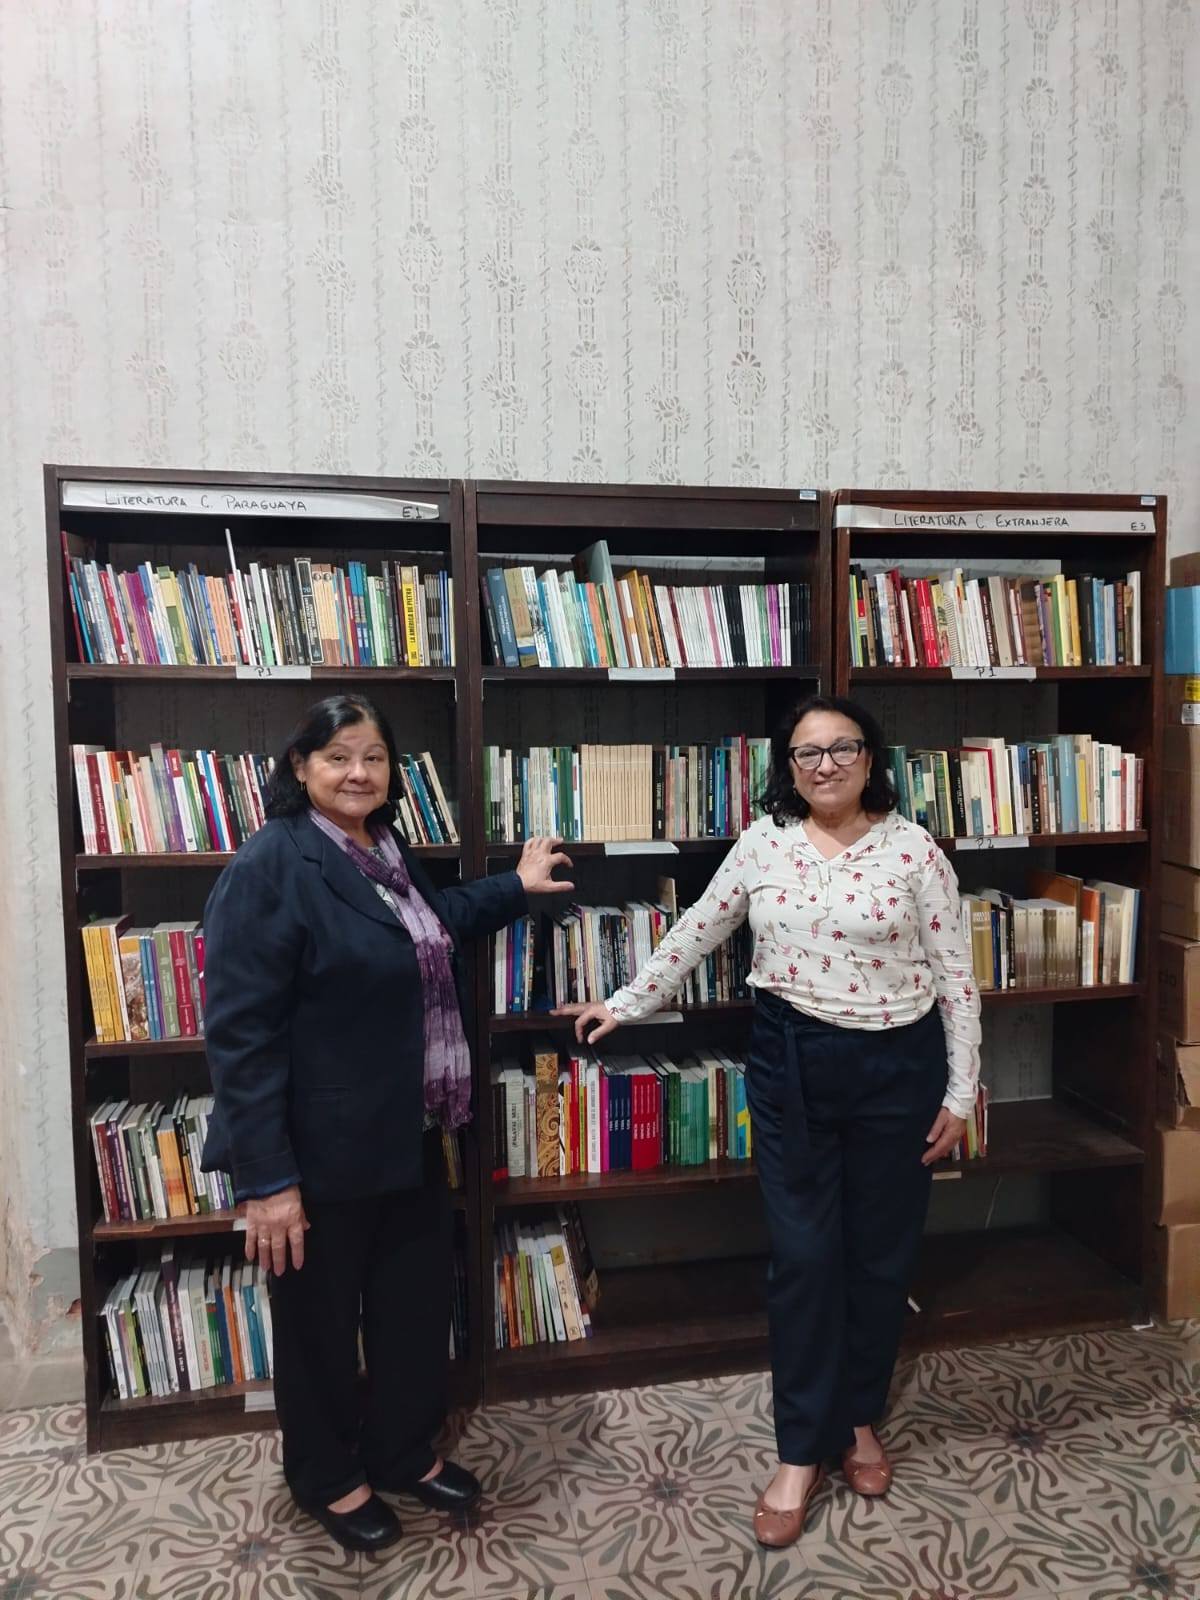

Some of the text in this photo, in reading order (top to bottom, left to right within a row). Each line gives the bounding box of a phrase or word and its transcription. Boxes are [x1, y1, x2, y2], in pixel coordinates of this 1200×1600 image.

[105, 488, 188, 507] LITERATURA
[224, 494, 307, 511] PARAGUAYA
[894, 512, 967, 527] LITERATURA
[995, 513, 1070, 528] EXTRANJERA
